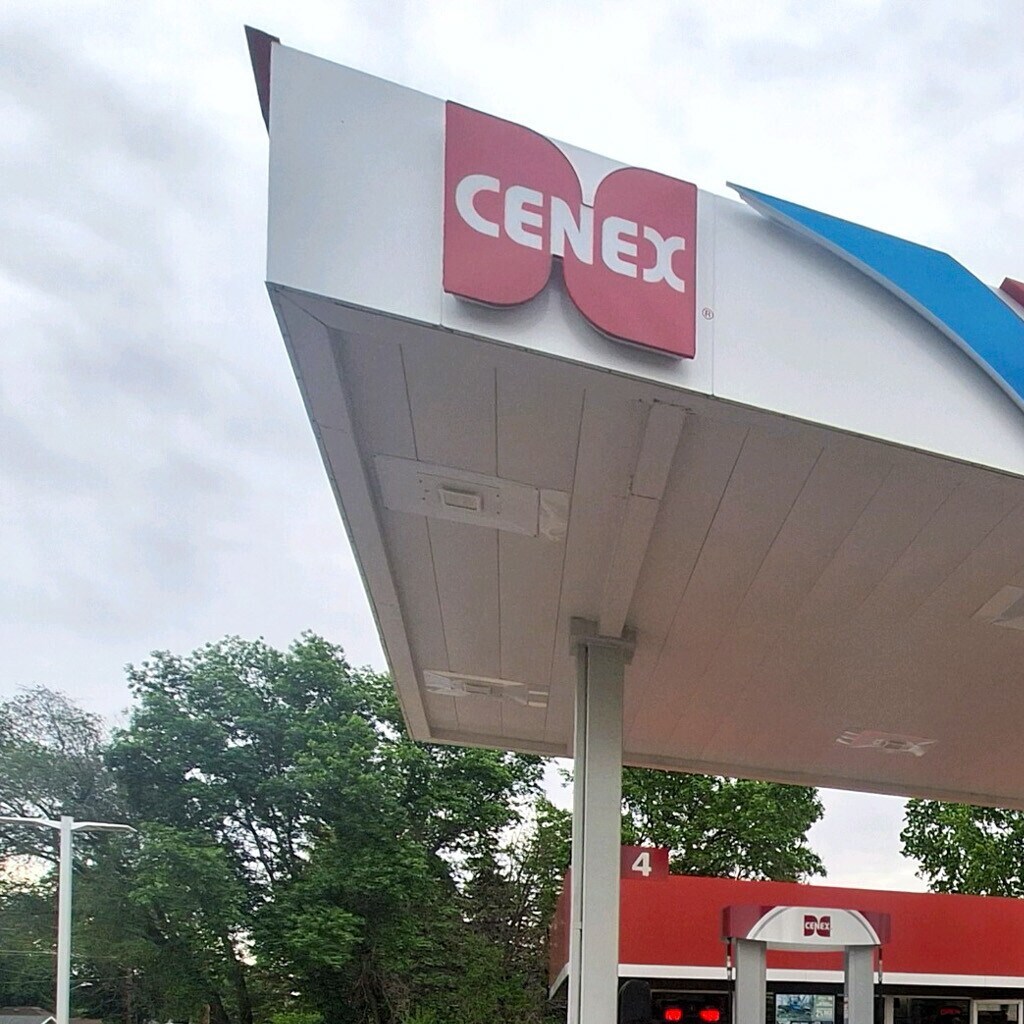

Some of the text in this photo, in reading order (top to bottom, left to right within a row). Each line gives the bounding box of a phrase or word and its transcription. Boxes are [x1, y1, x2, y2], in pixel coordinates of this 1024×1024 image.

[454, 173, 686, 294] CENEX
[631, 851, 653, 877] 4
[804, 921, 830, 931] CENEX
